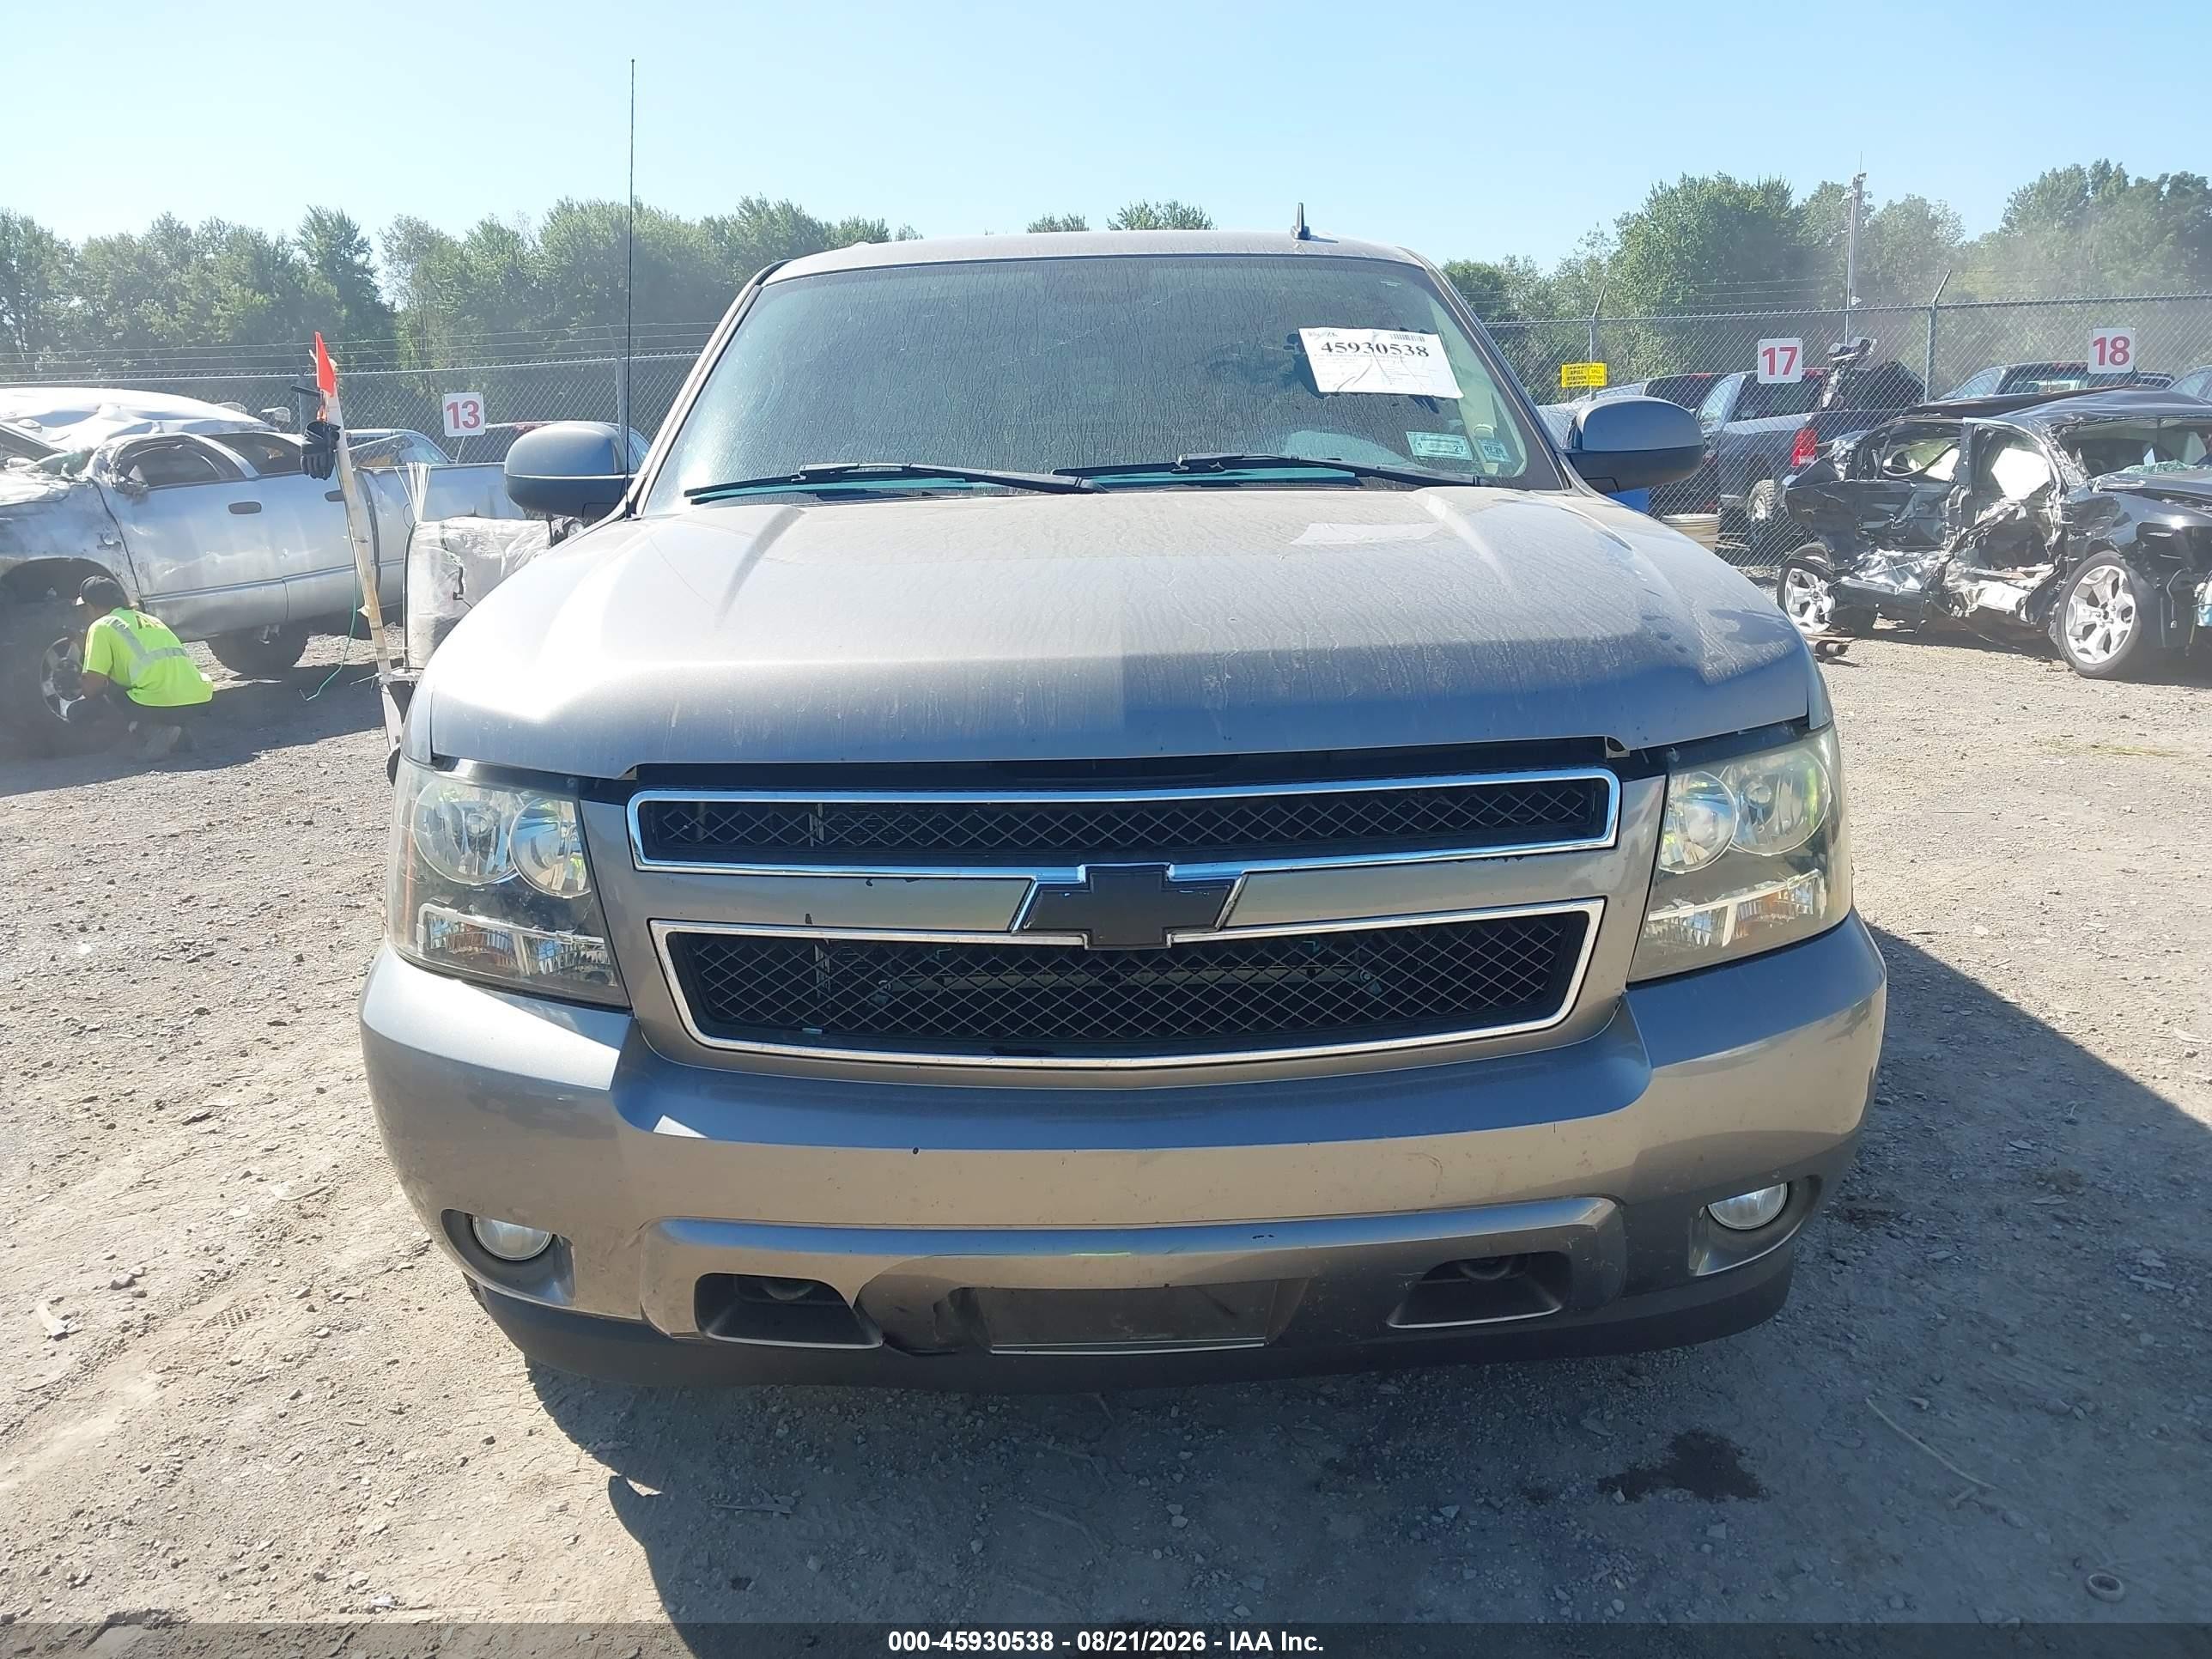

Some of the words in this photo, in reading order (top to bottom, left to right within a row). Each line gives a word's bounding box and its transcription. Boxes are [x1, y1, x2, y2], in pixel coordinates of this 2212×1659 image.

[1321, 341, 1430, 358] 45930538
[1762, 346, 1798, 375] 17
[2093, 336, 2130, 366] 18
[447, 400, 480, 429] 13
